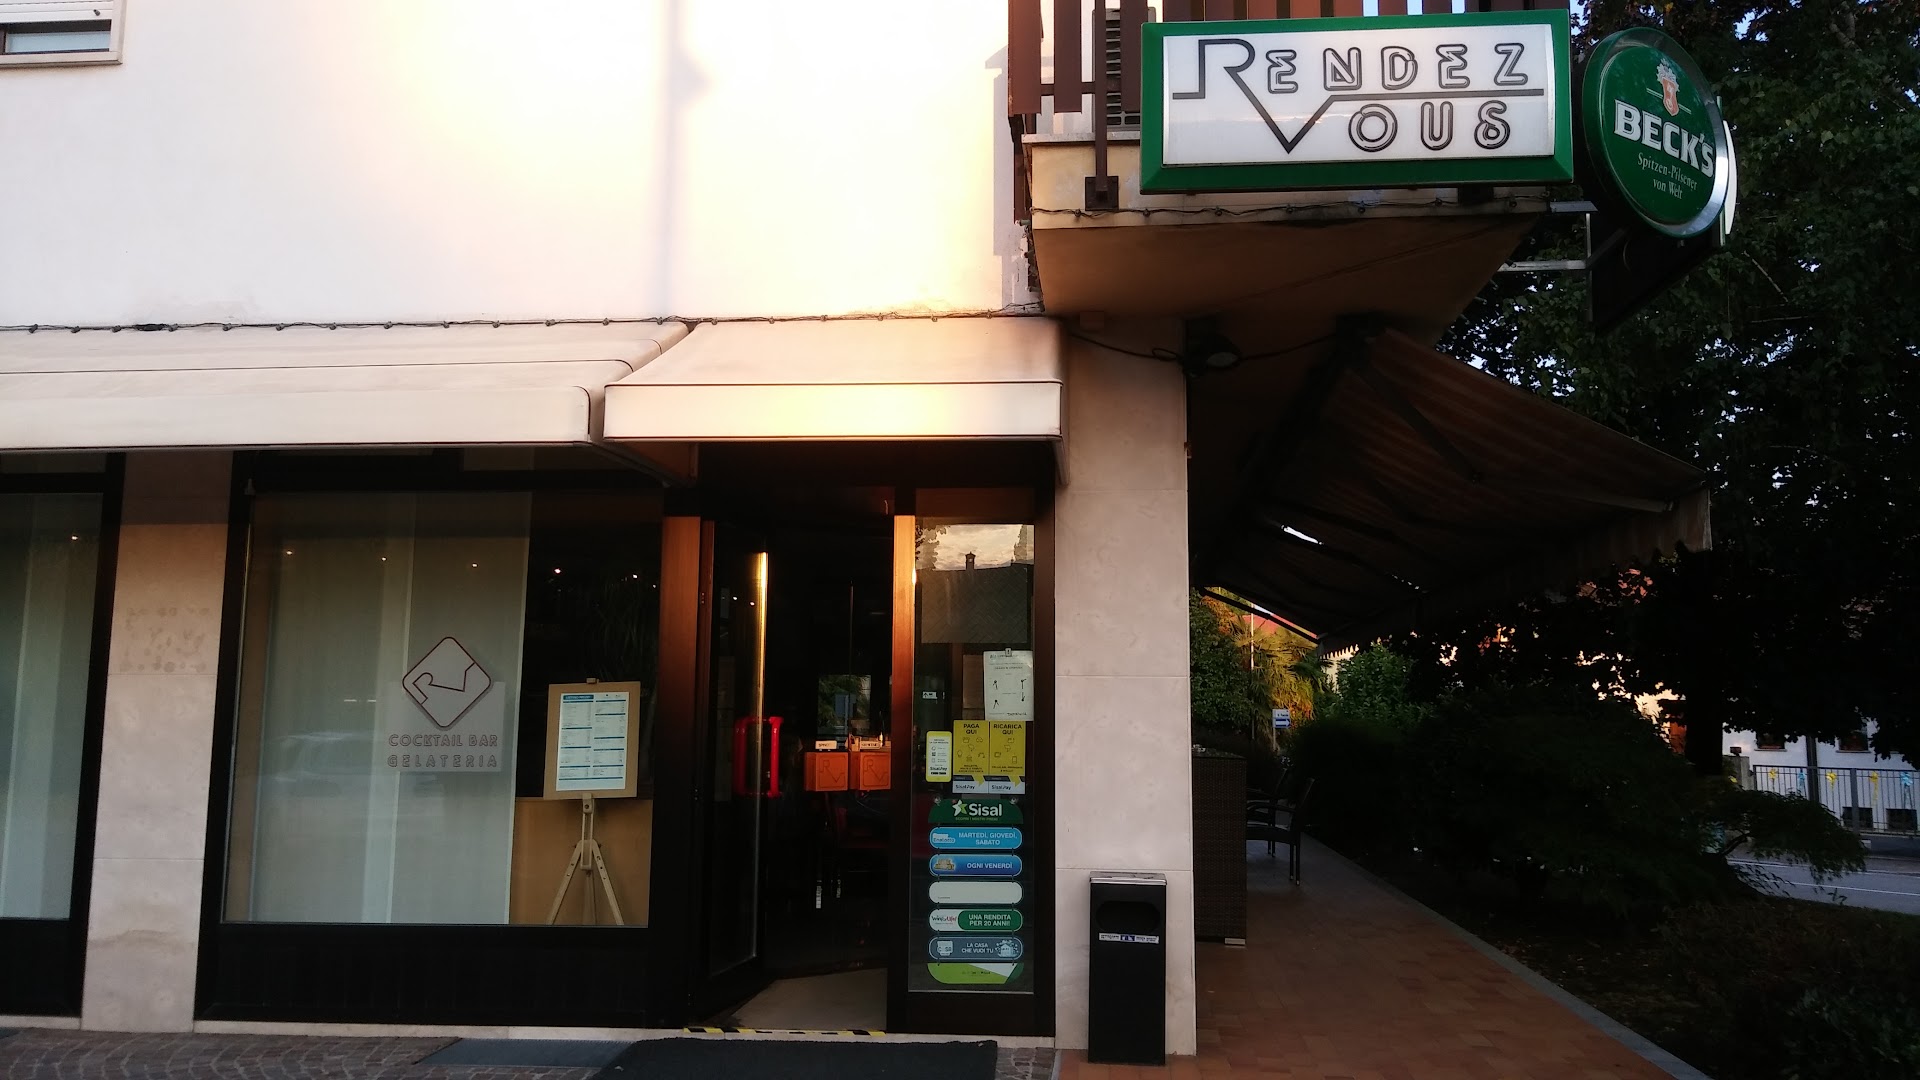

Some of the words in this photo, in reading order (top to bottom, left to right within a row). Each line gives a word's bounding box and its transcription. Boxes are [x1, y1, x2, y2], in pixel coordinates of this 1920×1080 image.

[1196, 38, 1530, 100] RENDEZ
[1255, 95, 1512, 155] VOUS
[1613, 99, 1716, 178] BECK'S
[1637, 152, 1698, 191] Spitzen-Pilsener
[1653, 178, 1667, 193] von
[1668, 180, 1683, 200] Welt
[388, 733, 464, 747] COCKTAIL
[468, 734, 498, 747] BAR
[387, 754, 498, 768] GELATERIA
[968, 803, 1003, 816] Sisal
[989, 831, 1018, 839] GIOVEDÌ,
[984, 861, 1013, 869] VENERDÌ
